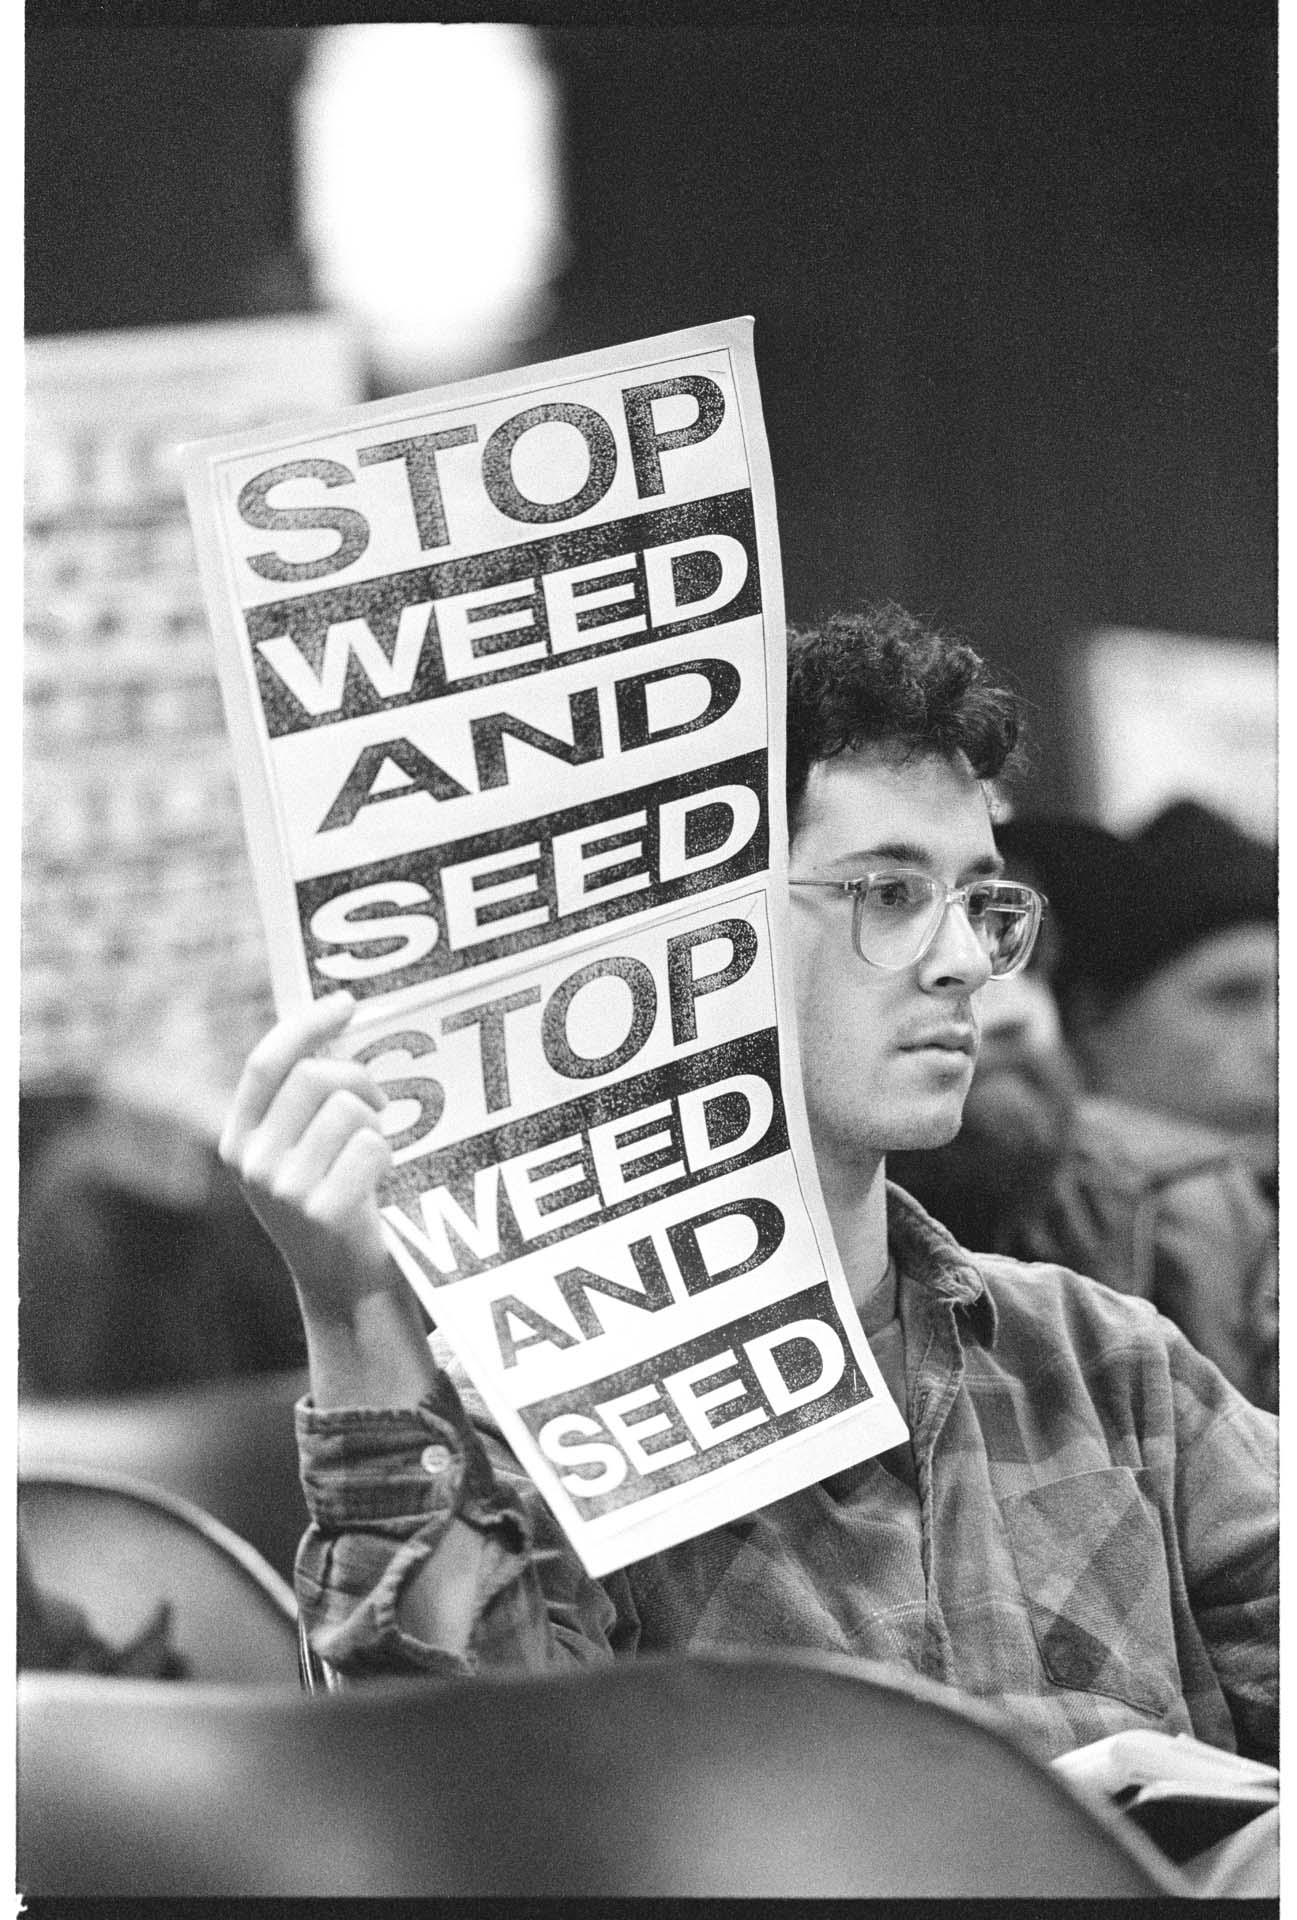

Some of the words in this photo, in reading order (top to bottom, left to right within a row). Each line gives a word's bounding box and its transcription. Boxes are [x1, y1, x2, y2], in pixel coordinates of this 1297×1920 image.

[236, 374, 727, 583] STOP
[257, 534, 750, 716] WEED
[316, 658, 742, 834] AND
[310, 784, 761, 980] SEED
[350, 917, 759, 1157] STOP
[380, 1074, 774, 1274] WEED
[490, 1197, 786, 1369] AND
[538, 1318, 846, 1498] SEED
